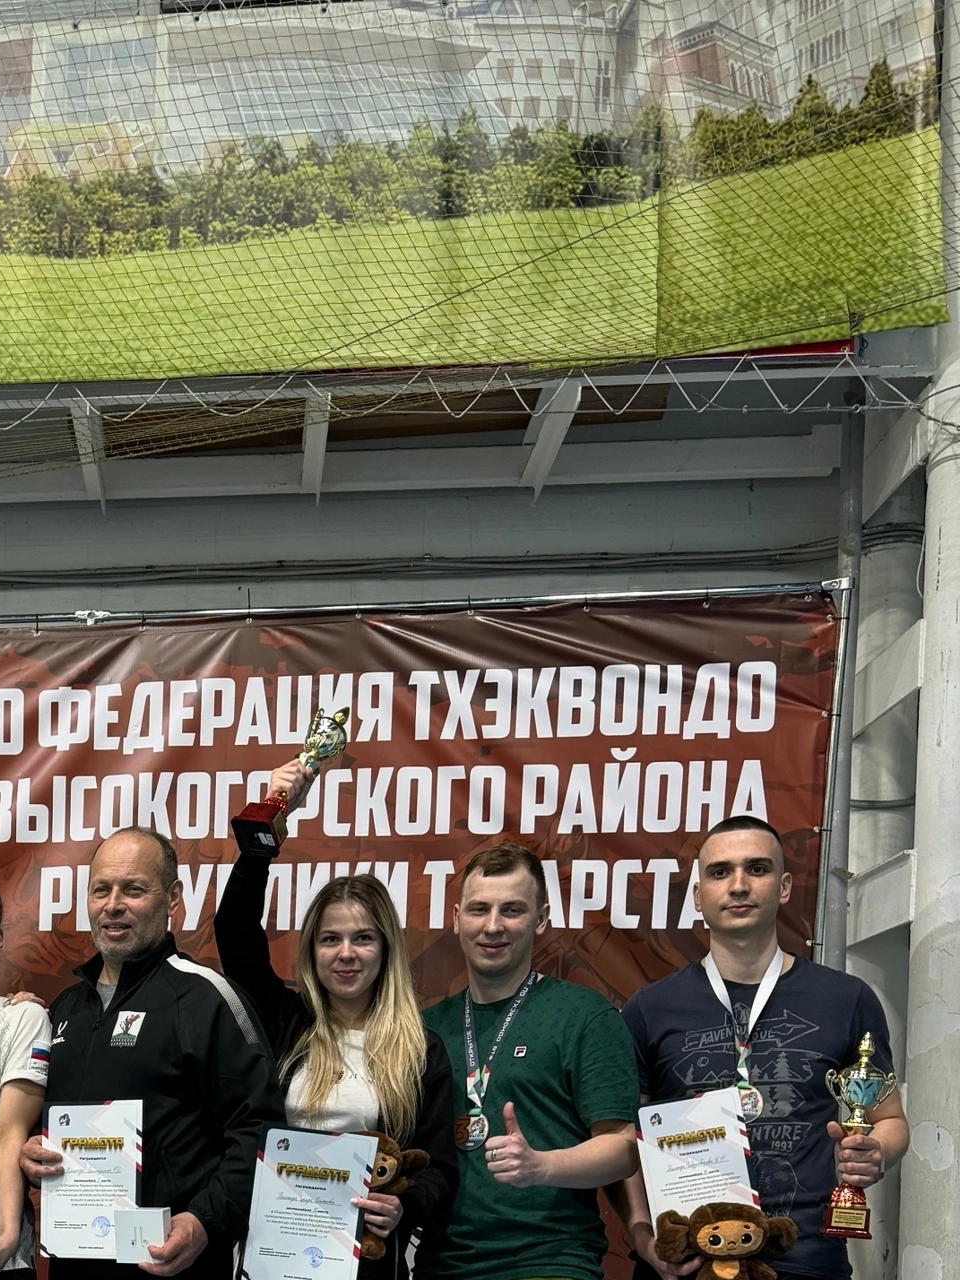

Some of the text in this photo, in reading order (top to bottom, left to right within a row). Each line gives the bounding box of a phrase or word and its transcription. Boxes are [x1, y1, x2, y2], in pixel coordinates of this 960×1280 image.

[38, 672, 394, 754] ФЕДЕРАЦИЯ
[409, 661, 777, 742] ТХЭКВОНДО
[521, 747, 768, 834] РАЙОНА
[61, 1136, 124, 1150] ГРАМОТА
[657, 1126, 727, 1149] ГРАМОТА
[276, 1162, 351, 1182] ГРАМОТА
